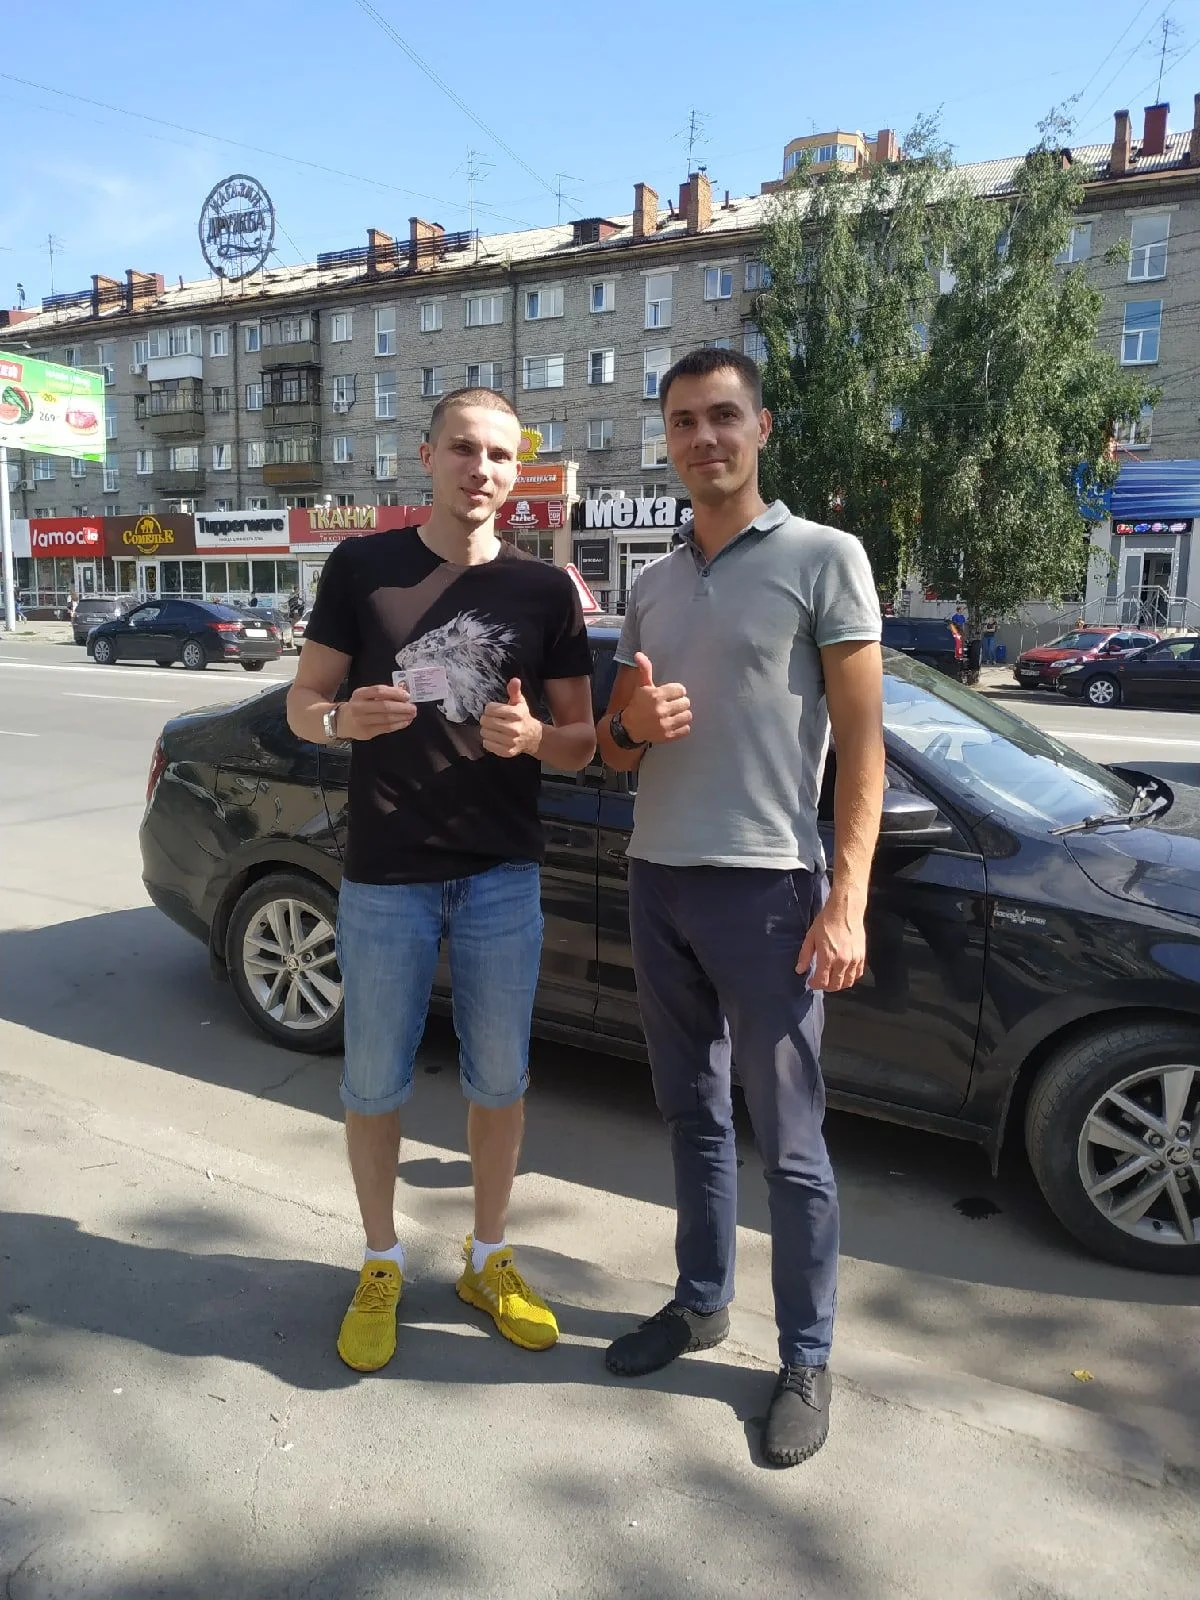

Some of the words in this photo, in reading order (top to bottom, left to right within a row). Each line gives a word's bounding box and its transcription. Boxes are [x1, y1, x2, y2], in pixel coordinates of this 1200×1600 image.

[197, 517, 284, 536] Tupperware
[307, 506, 376, 529] ТКАНИ
[32, 528, 98, 548] lamod
[122, 529, 175, 545] СОМЕЛЬЕ
